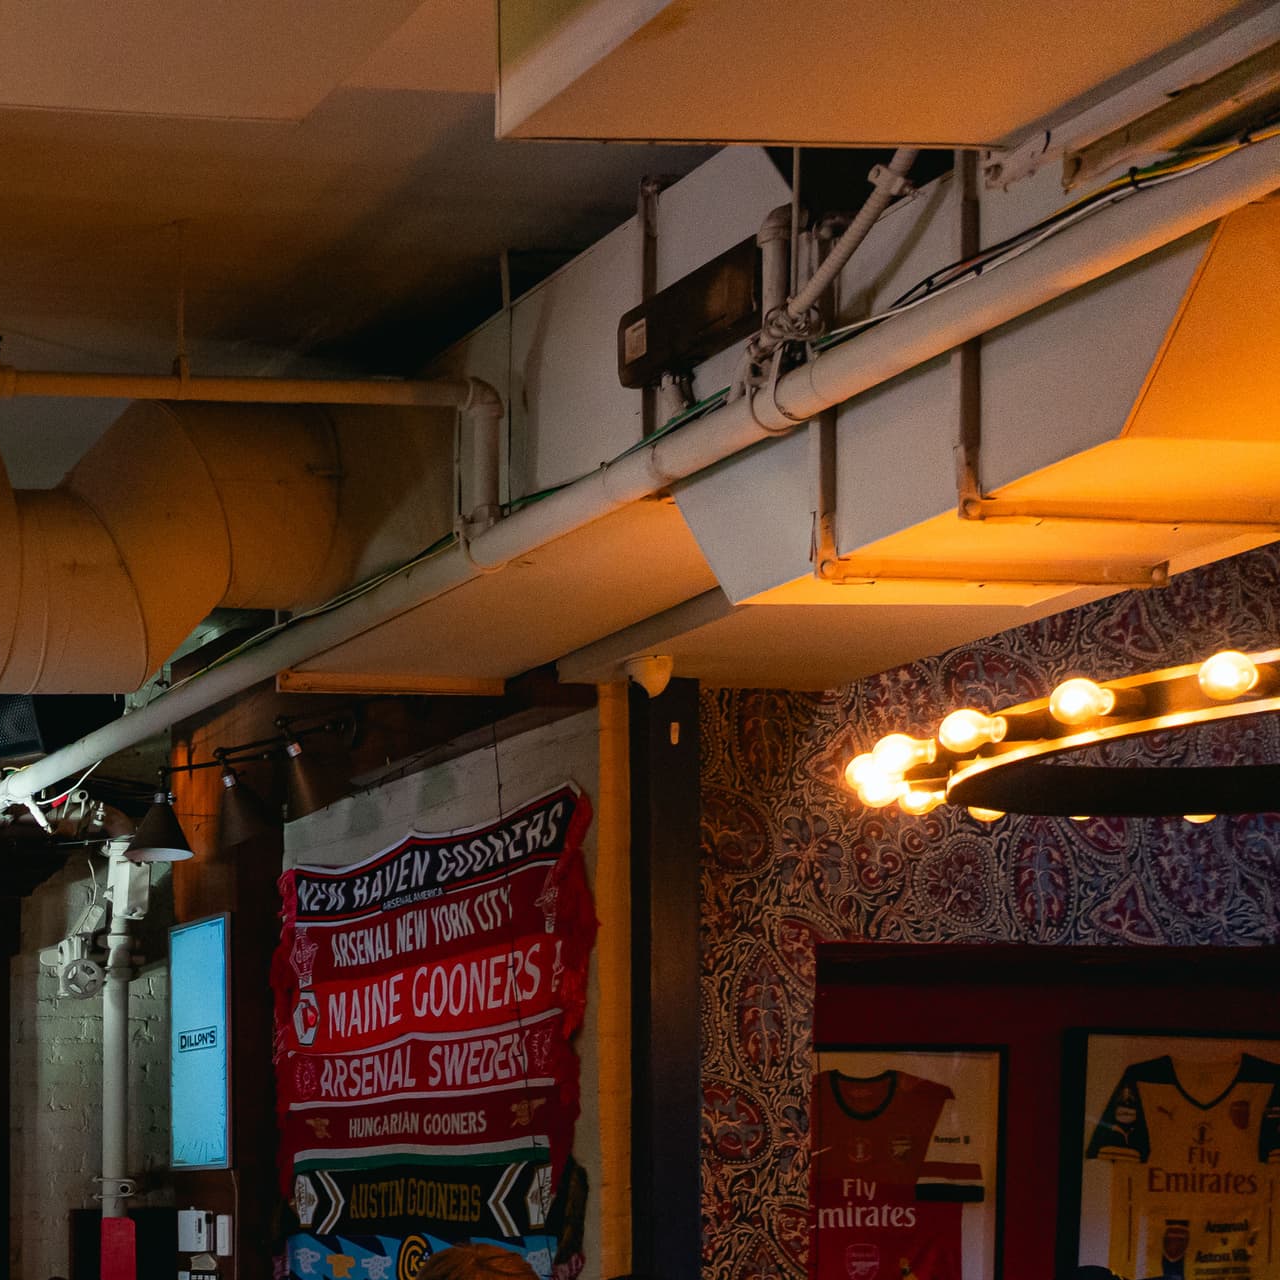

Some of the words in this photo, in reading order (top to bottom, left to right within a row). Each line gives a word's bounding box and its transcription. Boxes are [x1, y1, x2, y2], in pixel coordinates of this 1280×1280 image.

[298, 878, 346, 912] NEW
[352, 849, 430, 907] HAVEN
[436, 801, 564, 882] GOONERS
[331, 928, 393, 968] ARSENAL
[396, 908, 428, 955] NEW
[431, 898, 476, 944] YORK
[473, 883, 513, 932] CITY
[328, 972, 405, 1040] MAINE
[412, 941, 541, 1018] GOONERS
[180, 1030, 216, 1049] DILLON'S
[320, 1043, 417, 1097] ARSENAL
[427, 1029, 530, 1088] SWEDEN
[348, 1111, 419, 1139] HUNGARIAN
[423, 1109, 488, 1137] GOONERS
[1188, 1147, 1219, 1168] Fly
[842, 1178, 877, 1201] Fly
[1148, 1168, 1258, 1194] Emirates
[348, 1179, 402, 1222] AUSTIN
[407, 1178, 481, 1222] GOONERS
